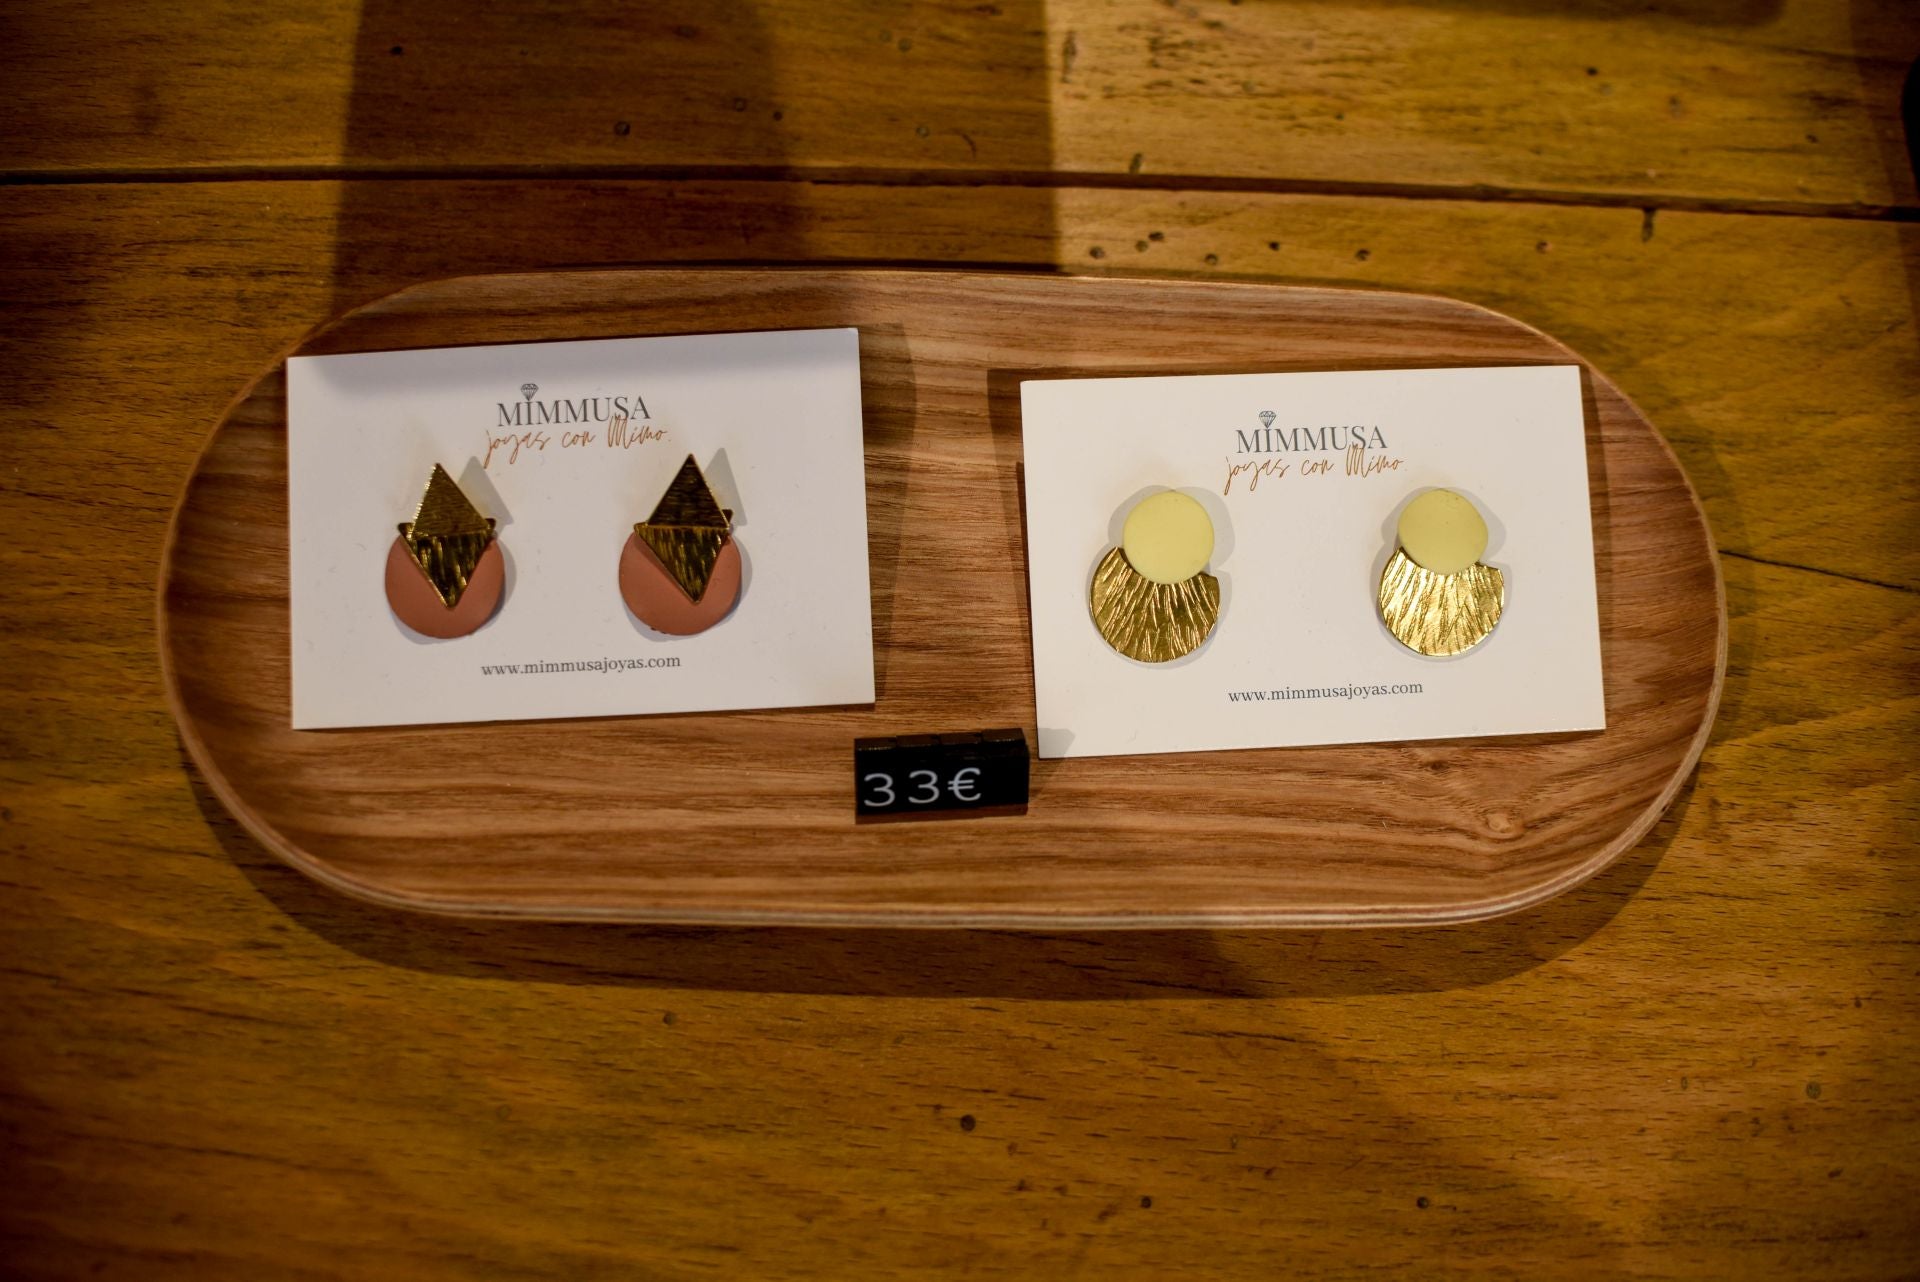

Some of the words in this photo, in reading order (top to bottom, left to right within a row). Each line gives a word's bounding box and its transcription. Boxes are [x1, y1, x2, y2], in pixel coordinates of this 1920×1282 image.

[497, 395, 652, 427] MIMMUSA
[483, 428, 551, 470] joyas
[561, 430, 597, 449] con
[1235, 425, 1388, 454] MIMMUSA
[1223, 455, 1291, 496] joyas
[1300, 458, 1335, 476] con
[480, 656, 681, 676] www.mimmusajoyas.com
[1228, 683, 1424, 703] www.mimmusajoyas.com
[863, 766, 982, 807] 33€
